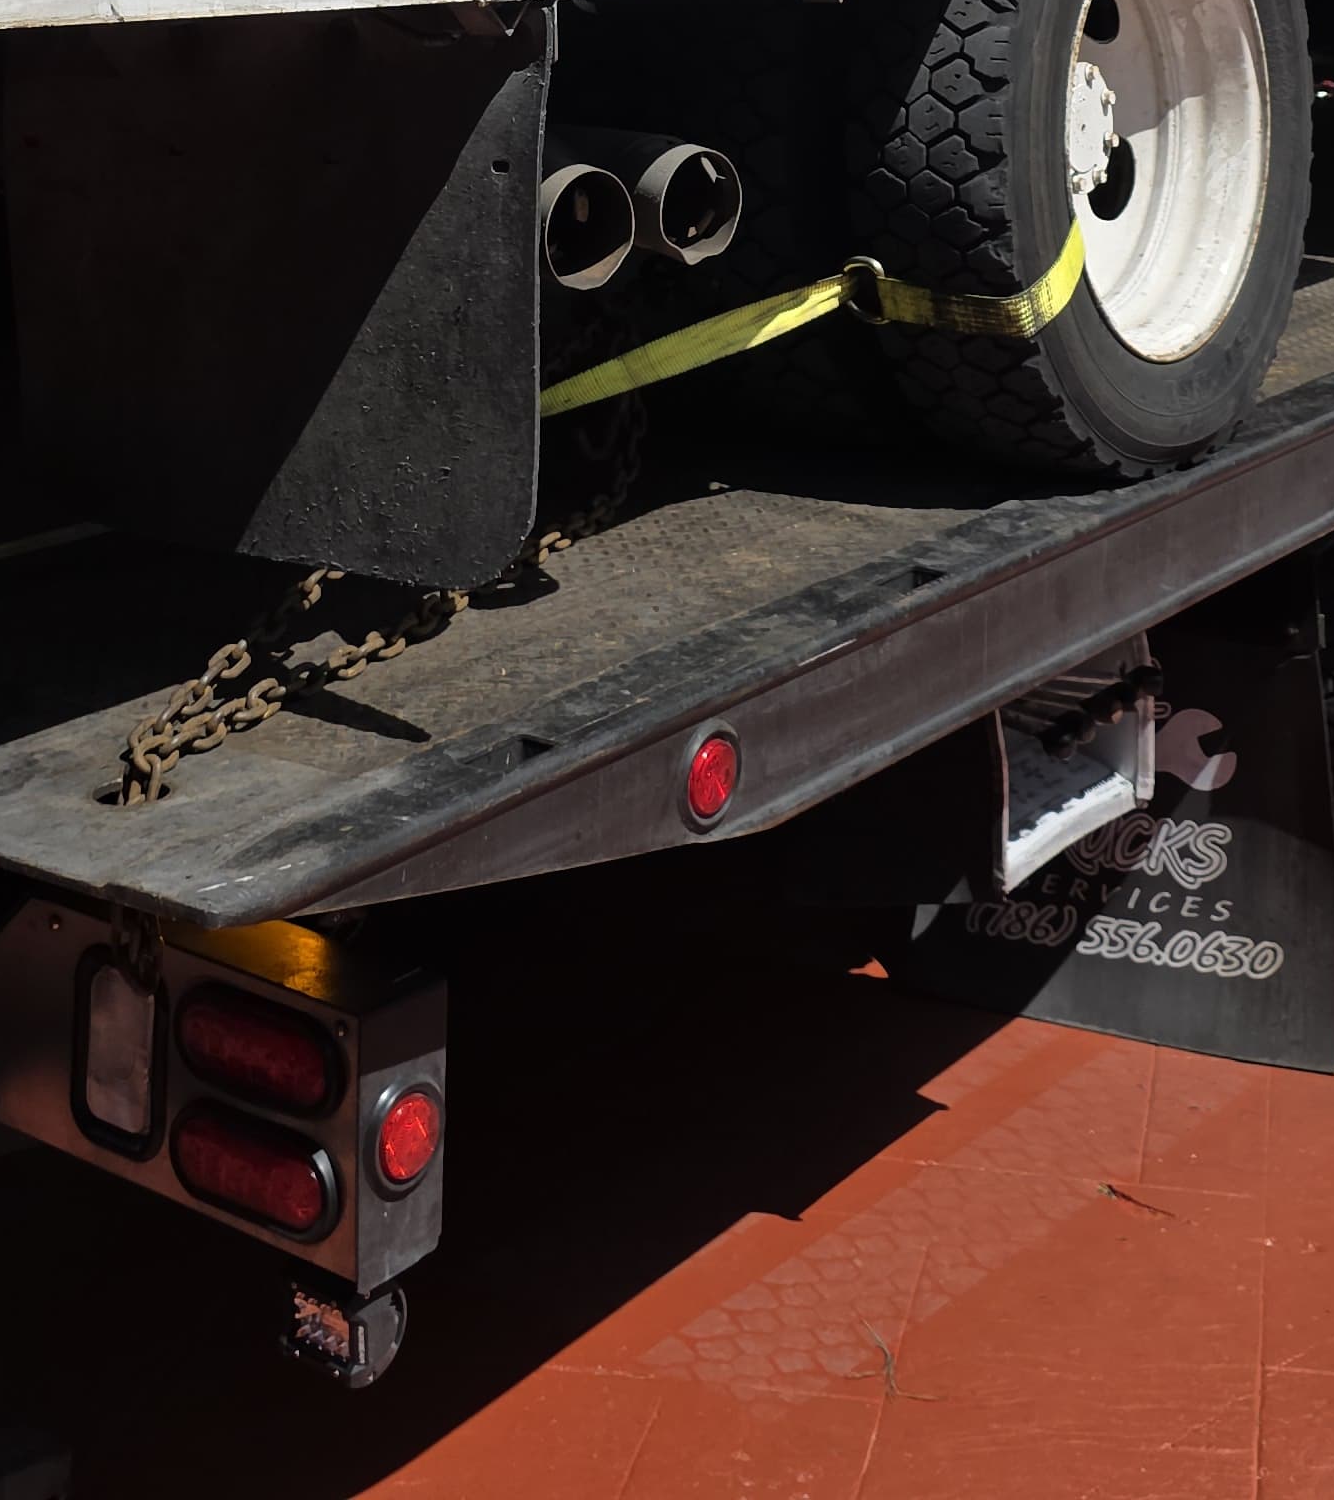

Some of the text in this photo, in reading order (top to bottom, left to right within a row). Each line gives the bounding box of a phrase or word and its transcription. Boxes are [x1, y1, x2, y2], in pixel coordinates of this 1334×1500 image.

[1023, 873, 1234, 922] ERVICES
[967, 902, 1285, 980] (786) 556.0630
